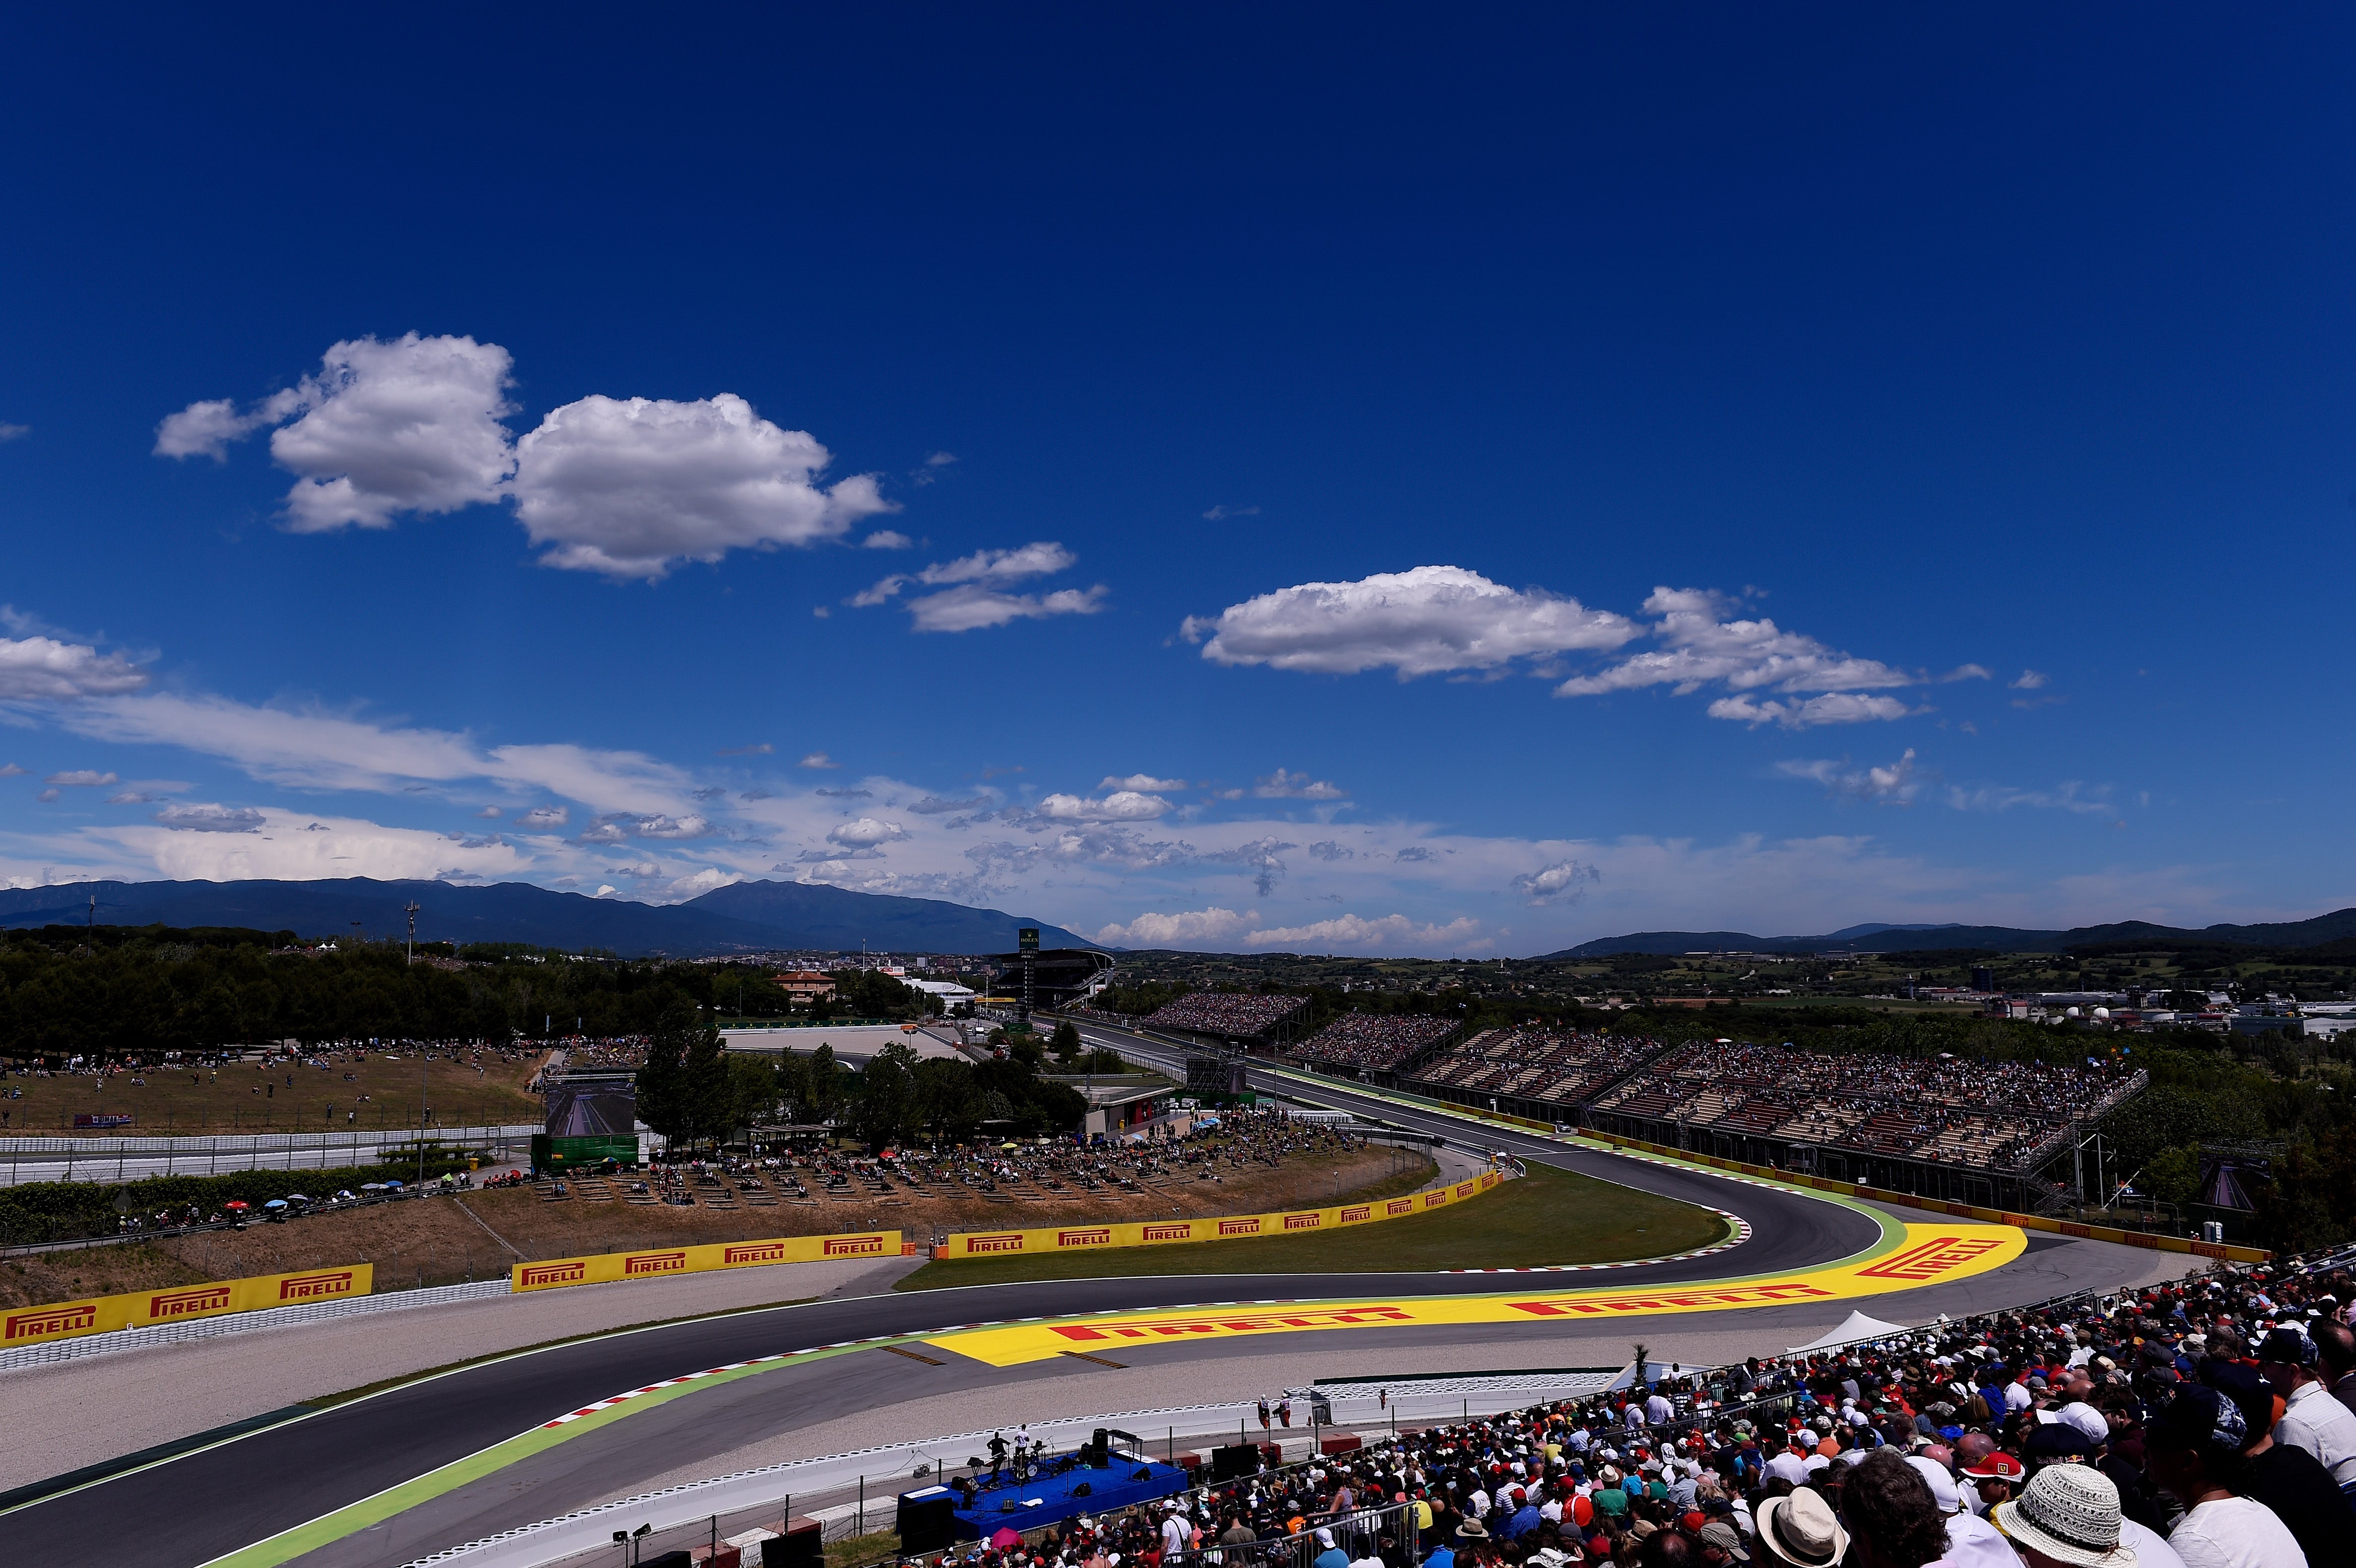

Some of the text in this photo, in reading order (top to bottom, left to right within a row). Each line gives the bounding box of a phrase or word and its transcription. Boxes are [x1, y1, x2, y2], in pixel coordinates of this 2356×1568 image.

[1680, 1151, 1695, 1161] PIRELLI
[1710, 1158, 1725, 1168] PIRELLI
[1741, 1164, 1759, 1175] PIRELLI
[1775, 1171, 1794, 1182] PIRELLI
[1482, 1173, 1494, 1188] PIRELLI
[1812, 1178, 1832, 1190] PIRELLI
[1457, 1183, 1473, 1198] PIRELLI
[1854, 1186, 1876, 1199] PIRELLI
[1387, 1199, 1411, 1215] PIRELLI
[1426, 1191, 1445, 1207] PIRELLI
[1898, 1194, 1921, 1208] PIRELLI
[1341, 1207, 1370, 1222] PIRELLI
[1947, 1203, 1972, 1217] PIRELLI
[1219, 1219, 1259, 1235] PIRELLI
[1284, 1213, 1319, 1229] PIRELLI
[2001, 1213, 2029, 1228] PIRELLI
[1058, 1229, 1110, 1246] PIRELLI
[1143, 1224, 1190, 1240] PIRELLI
[2060, 1222, 2090, 1237] PIRELLI
[824, 1237, 883, 1255] PIRELLI
[967, 1235, 1023, 1252] PIRELLI
[2124, 1233, 2158, 1248] PIRELLI
[724, 1243, 784, 1263] PIRELLI
[1854, 1237, 2005, 1279] PIRELLI
[2190, 1243, 2227, 1258] PIRELLI
[626, 1253, 686, 1273] PIRELLI
[522, 1263, 585, 1286] PIRELLI
[280, 1272, 352, 1300] PIRELLI
[150, 1287, 231, 1318] PIRELLI
[1506, 1284, 1836, 1316] PIRELLI
[5, 1305, 96, 1339] PIRELLI
[1048, 1307, 1416, 1340] PIRELLI
